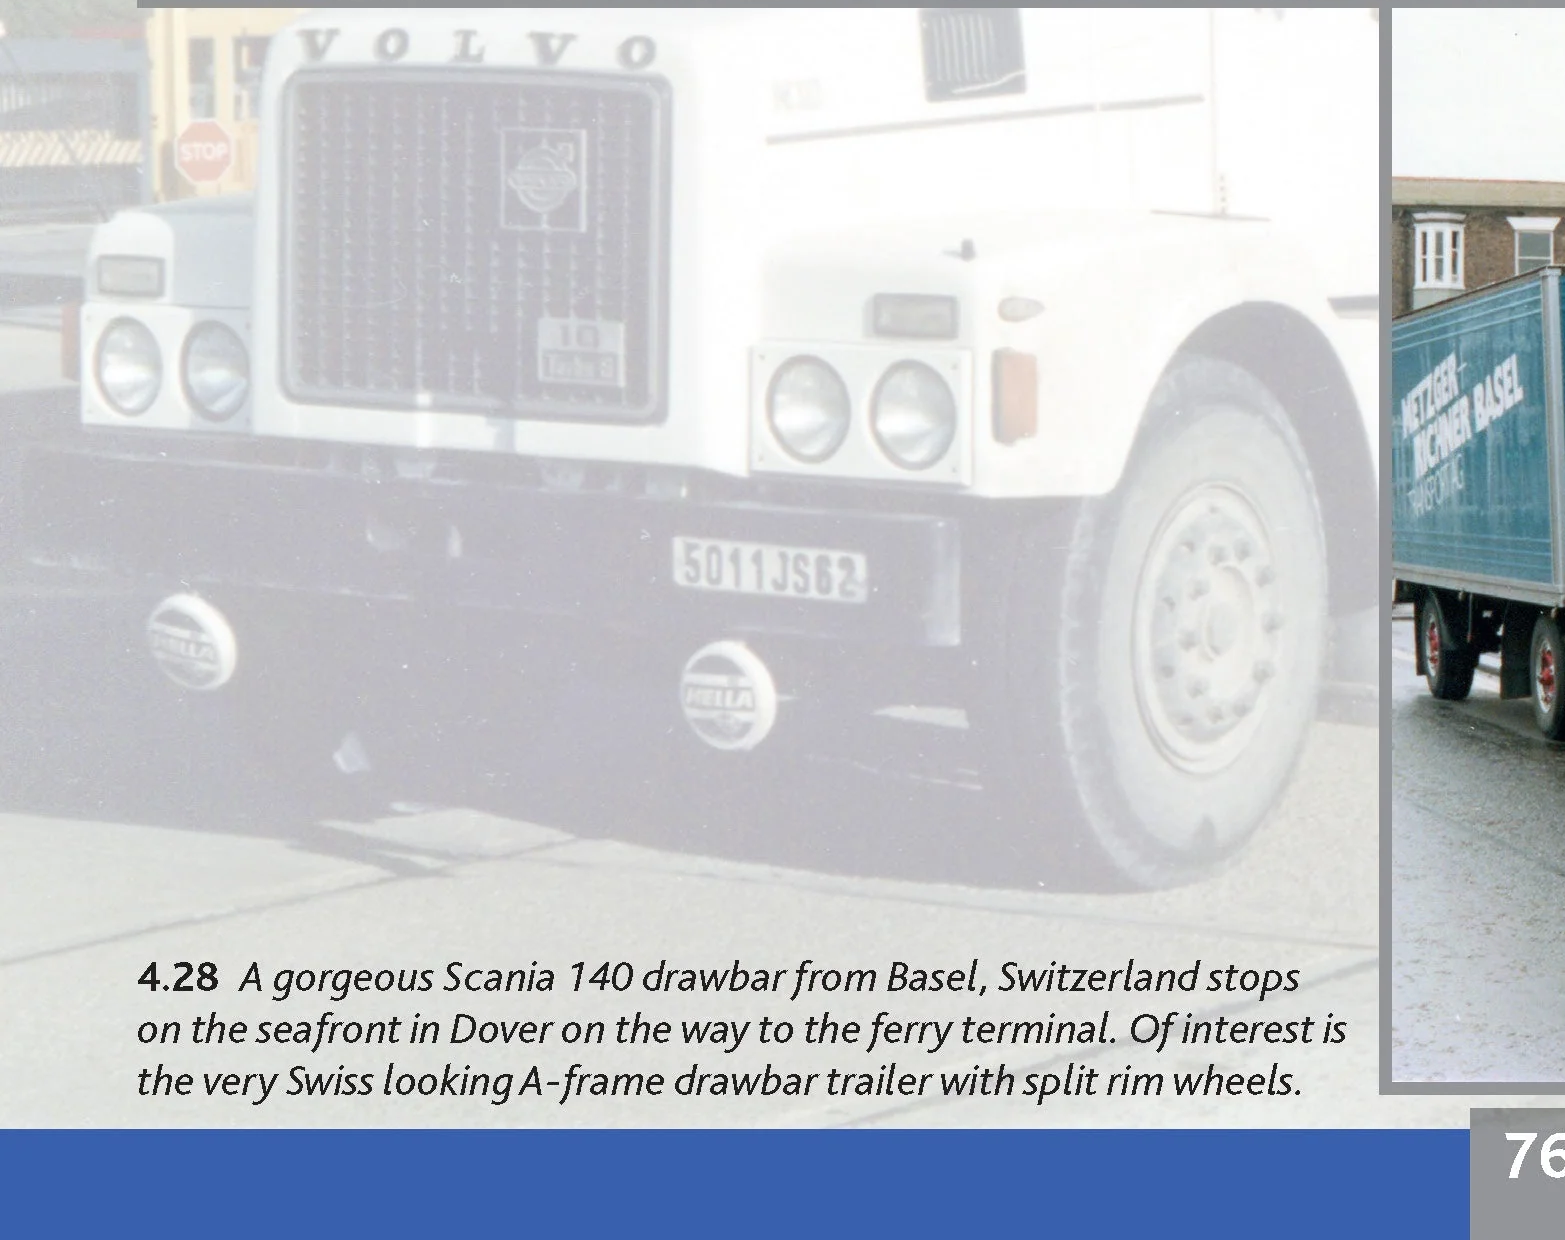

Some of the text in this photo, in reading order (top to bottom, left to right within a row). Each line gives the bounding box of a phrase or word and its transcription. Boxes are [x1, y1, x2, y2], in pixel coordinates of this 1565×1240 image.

[299, 27, 657, 71] VOLVO
[179, 141, 229, 161] STOP
[1473, 353, 1524, 433] BASEL
[683, 539, 858, 599] 5011JS62
[685, 686, 754, 709] HELLA
